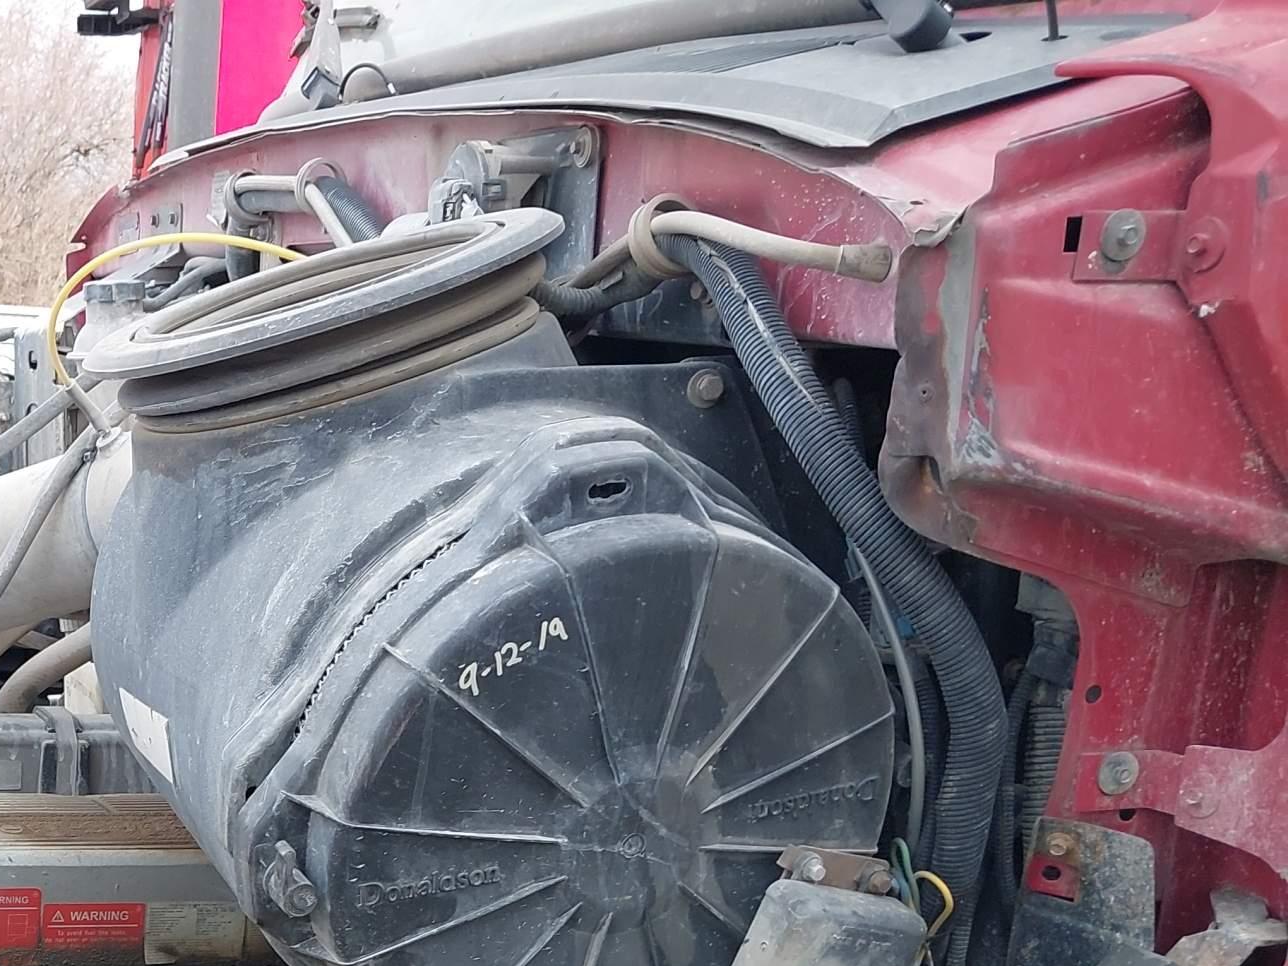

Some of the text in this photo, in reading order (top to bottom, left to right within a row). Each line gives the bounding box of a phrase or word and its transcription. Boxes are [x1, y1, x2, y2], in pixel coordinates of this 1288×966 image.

[458, 617, 569, 697] 9-12-19
[356, 864, 502, 908] Donaldson
[70, 910, 129, 921] WARNING
